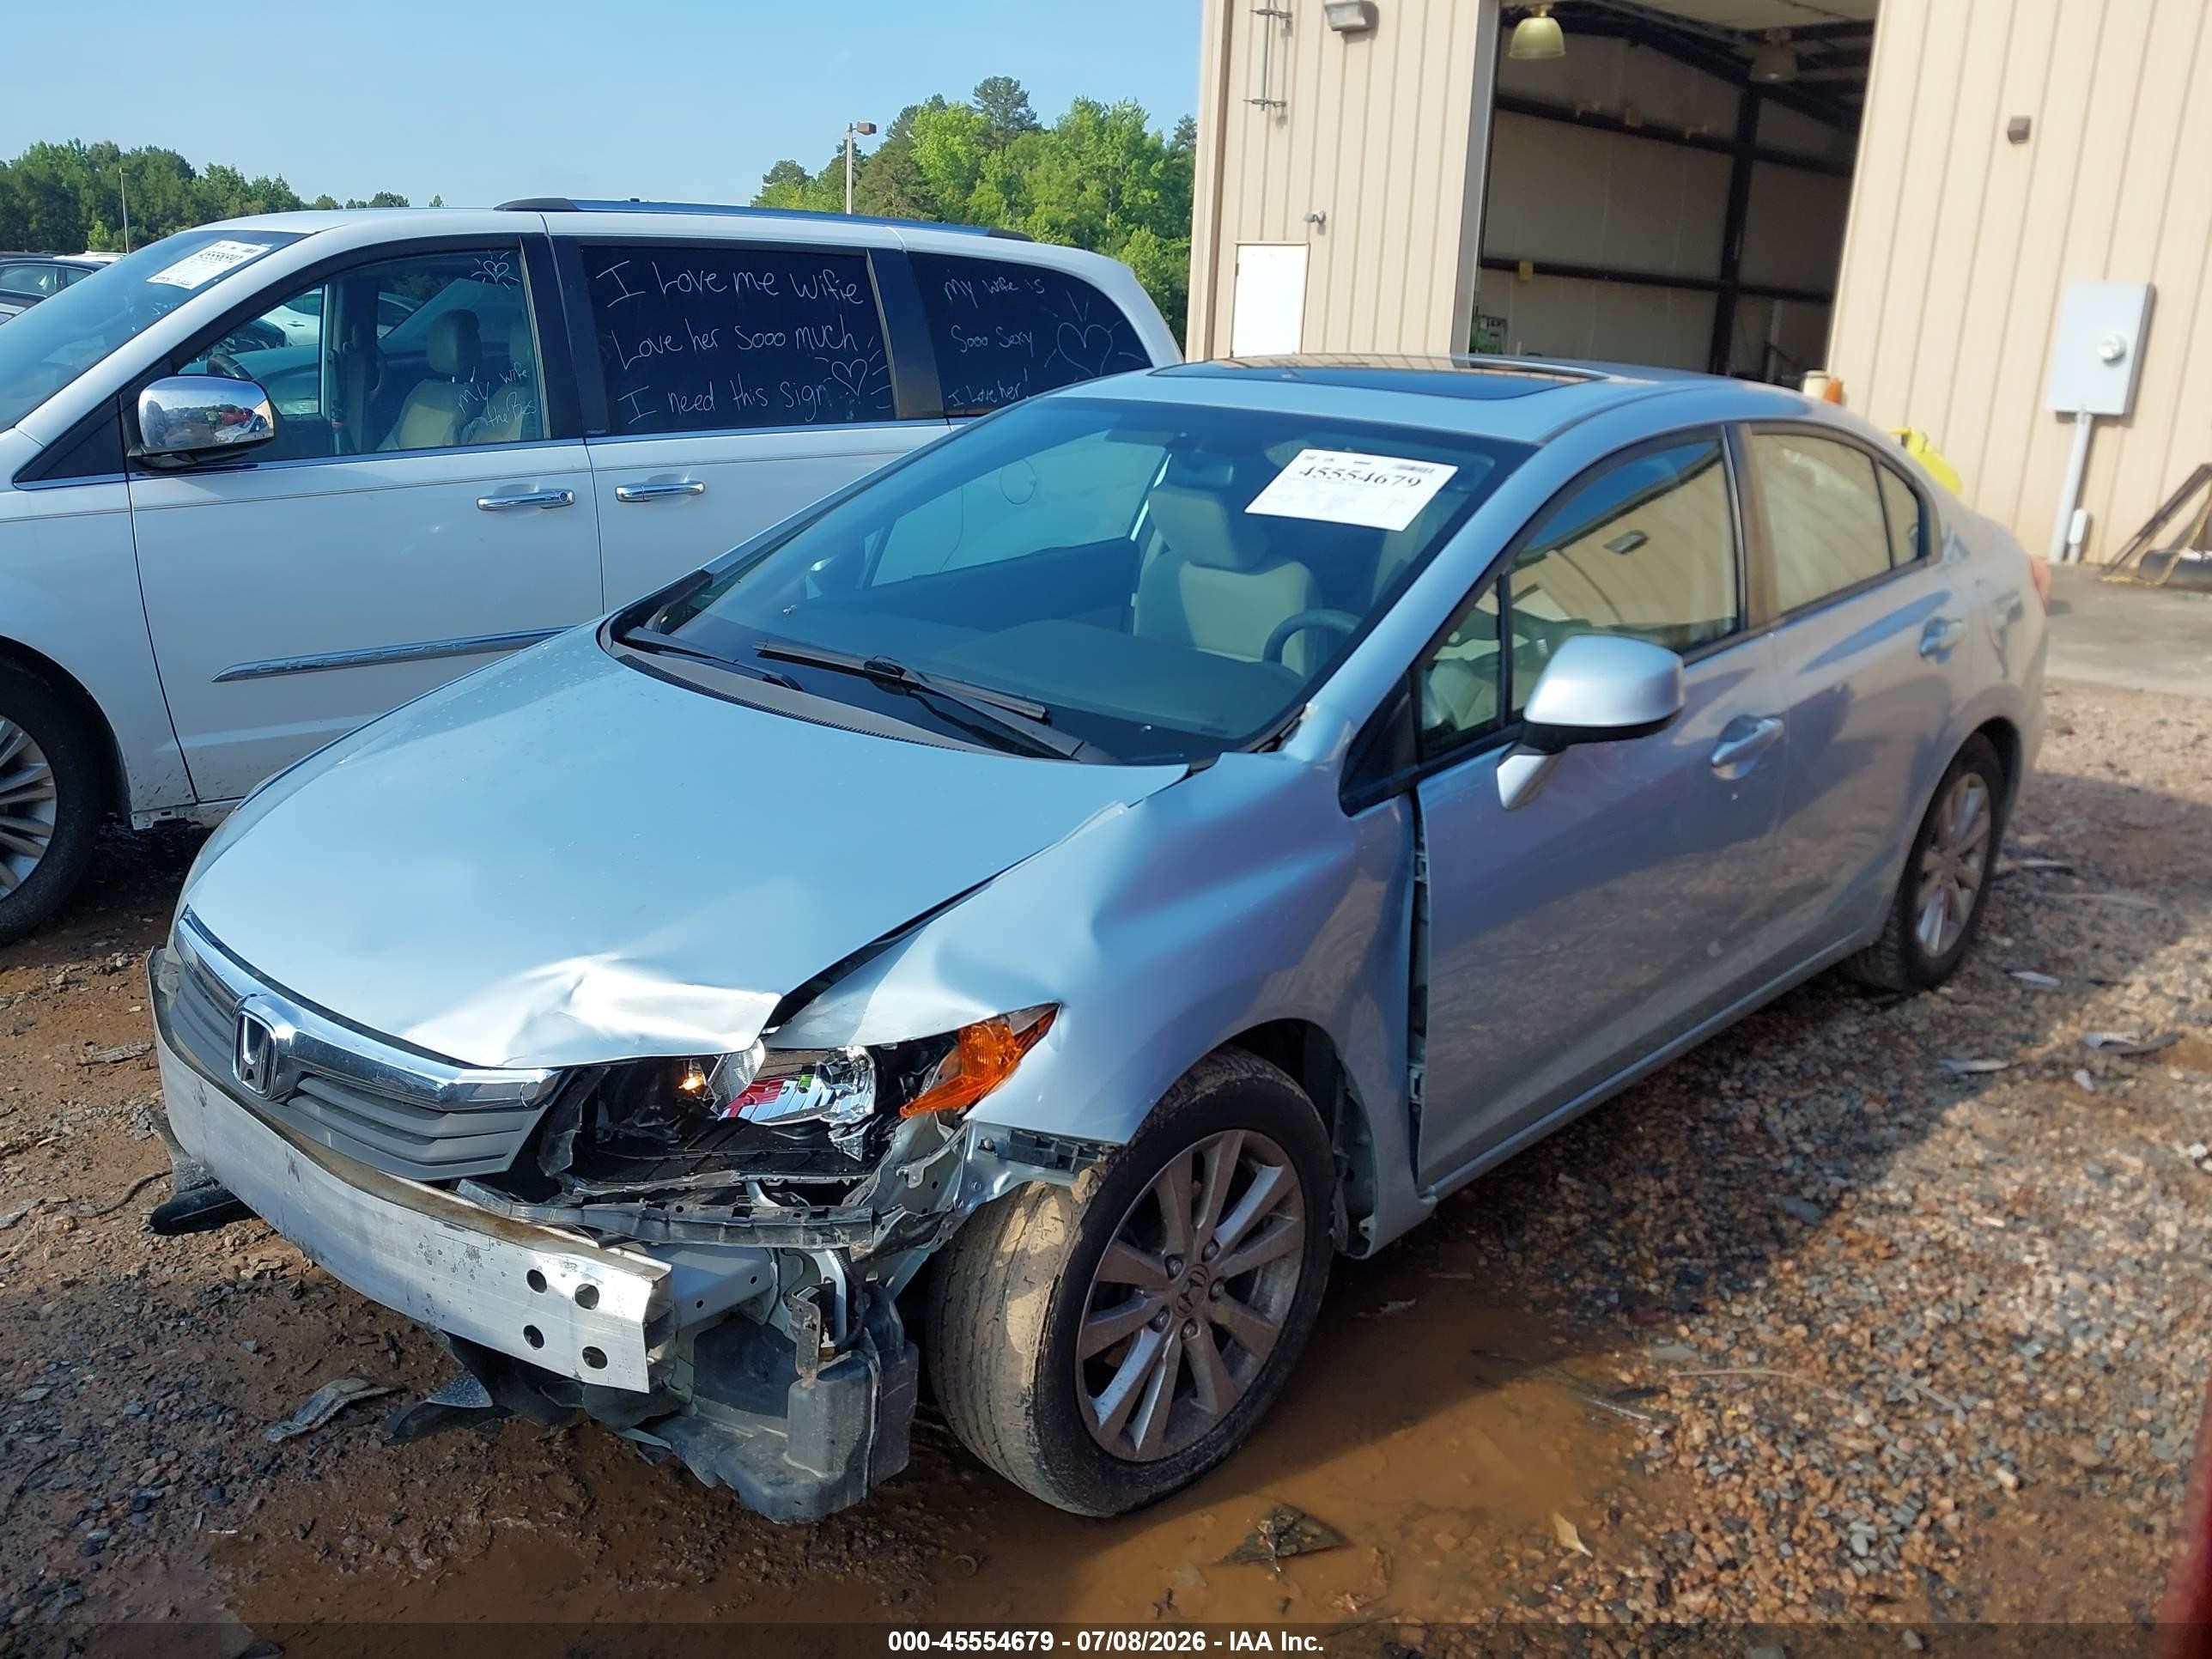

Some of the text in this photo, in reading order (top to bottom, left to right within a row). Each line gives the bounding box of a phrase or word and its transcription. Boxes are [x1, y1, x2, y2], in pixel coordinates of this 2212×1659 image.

[595, 260, 646, 308] I
[651, 261, 728, 295] Love
[732, 270, 780, 295] me
[1024, 278, 1045, 295] is
[611, 329, 684, 370] Love
[684, 318, 720, 351] her
[794, 313, 858, 351] much
[617, 385, 658, 424] I
[667, 380, 715, 416] need
[730, 374, 769, 410] this
[947, 389, 964, 406] I
[1298, 465, 1423, 488] 45554679
